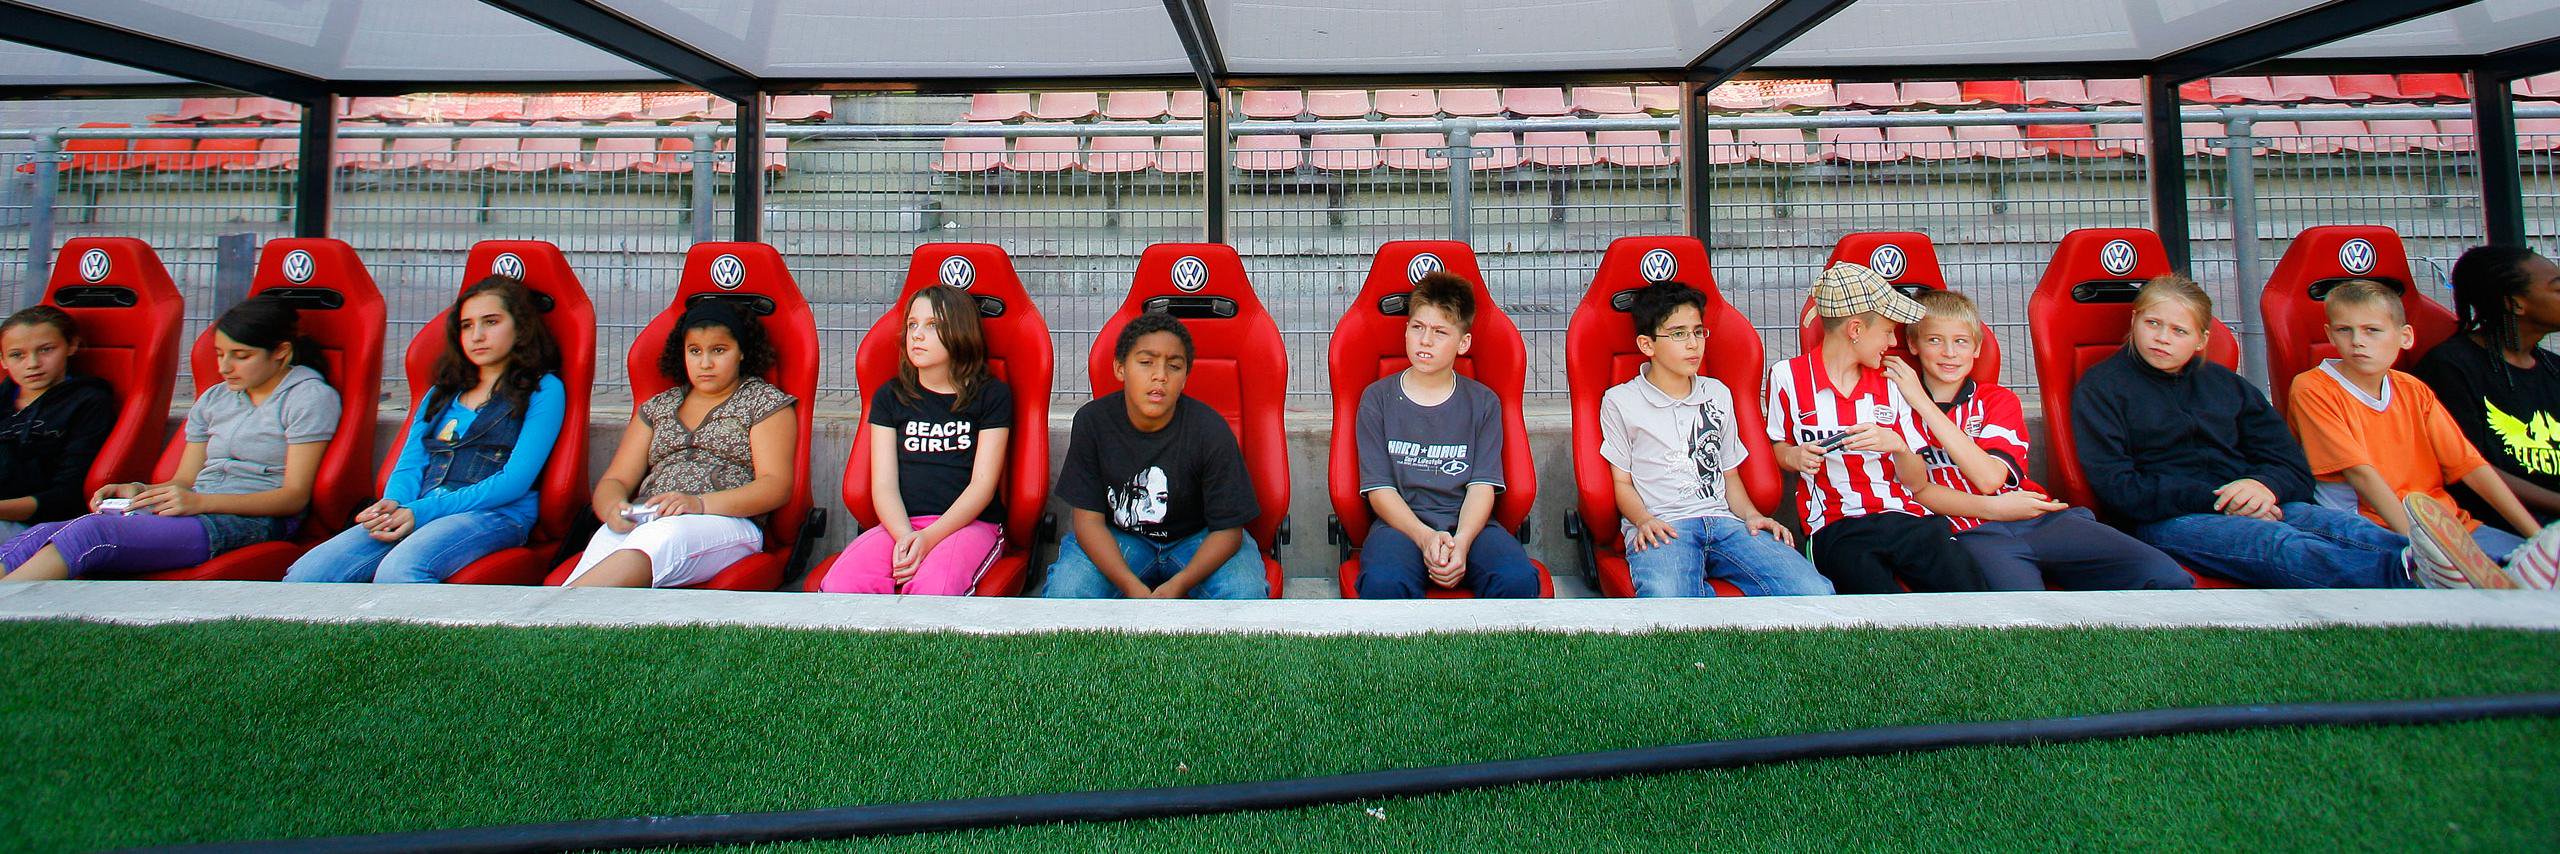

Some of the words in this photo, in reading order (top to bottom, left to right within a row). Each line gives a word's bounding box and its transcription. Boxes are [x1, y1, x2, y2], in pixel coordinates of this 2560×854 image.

[82, 250, 110, 281] VW
[285, 251, 313, 282] VW
[494, 255, 523, 279] VW
[713, 256, 743, 288] VW
[1643, 251, 1675, 283] VW
[1873, 246, 1904, 279] VW
[2103, 241, 2135, 273] VW
[2341, 240, 2374, 273] VW
[942, 258, 973, 289] VW
[1174, 258, 1206, 290] VW
[904, 434, 971, 452] GIRLS
[905, 420, 971, 437] BEACH
[1388, 441, 1420, 456] HARD
[1426, 445, 1467, 458] WAVE
